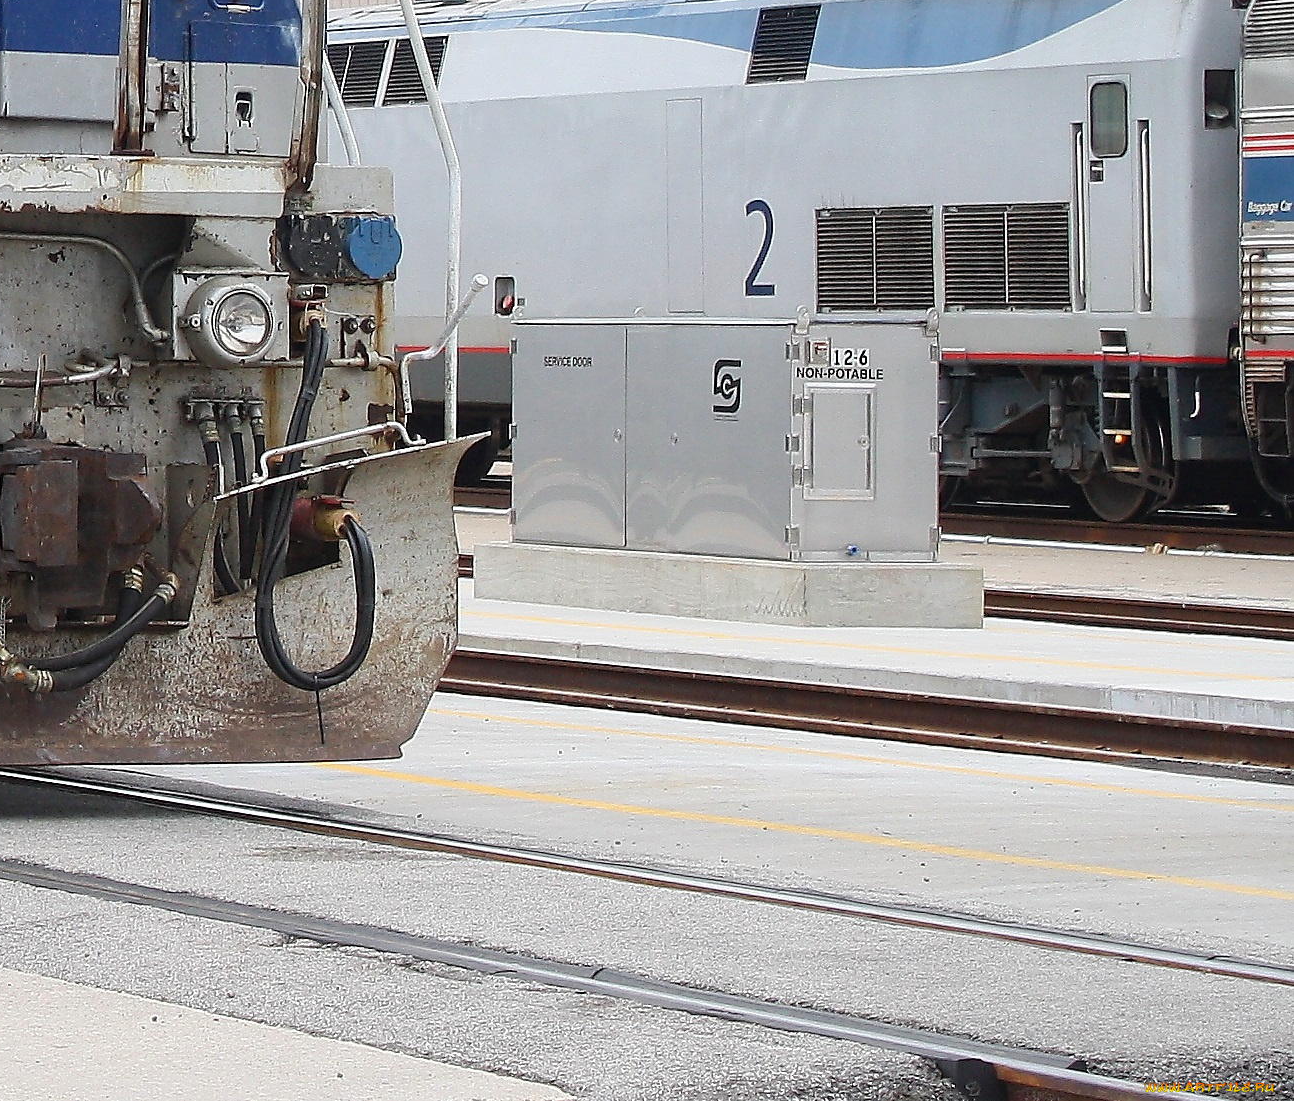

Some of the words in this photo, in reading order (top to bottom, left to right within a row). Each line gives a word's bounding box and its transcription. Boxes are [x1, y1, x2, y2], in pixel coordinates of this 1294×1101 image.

[743, 199, 776, 297] 2
[544, 356, 571, 367] SERVICE
[572, 356, 592, 367] DOOR
[833, 349, 869, 366] 12-6
[796, 367, 884, 380] NON-POTABLE
